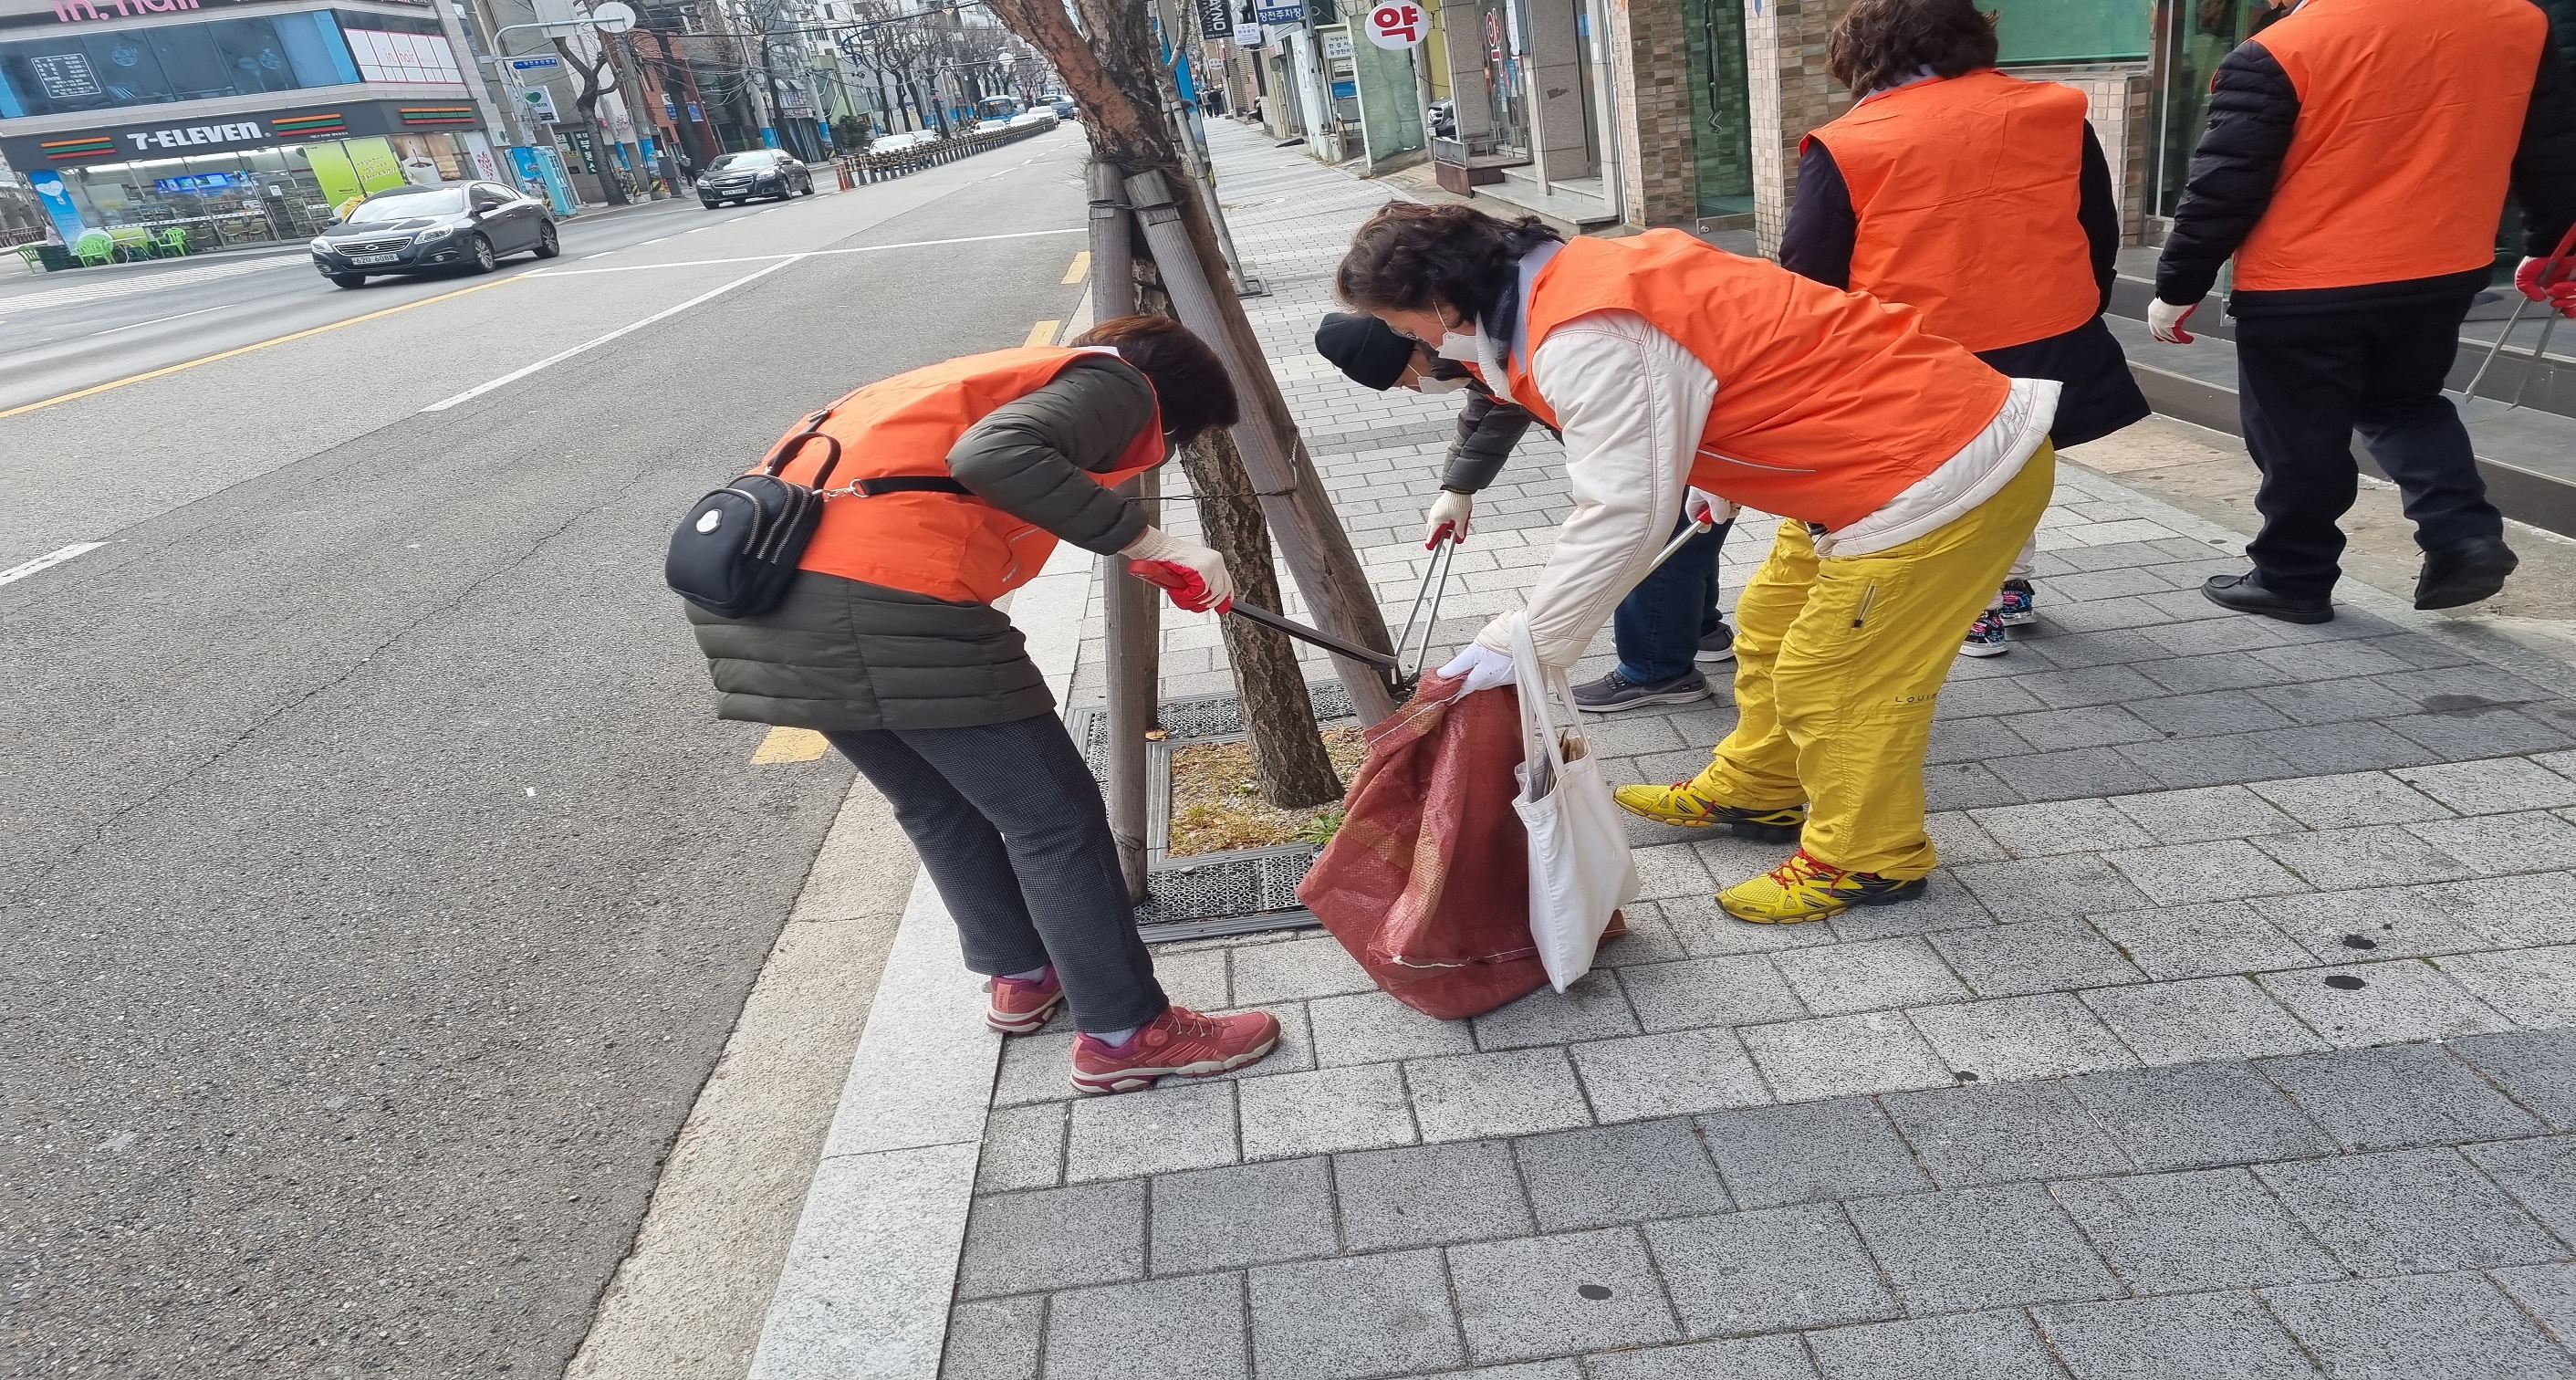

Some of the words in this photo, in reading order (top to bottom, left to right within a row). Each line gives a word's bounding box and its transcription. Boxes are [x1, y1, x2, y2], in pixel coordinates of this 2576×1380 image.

[1258, 7, 1302, 22] 장전주차장
[1374, 5, 1419, 42] 약
[398, 49, 416, 64] hair
[126, 121, 263, 151] 7-ELEVEN
[1894, 693, 1938, 703] LOUIS
